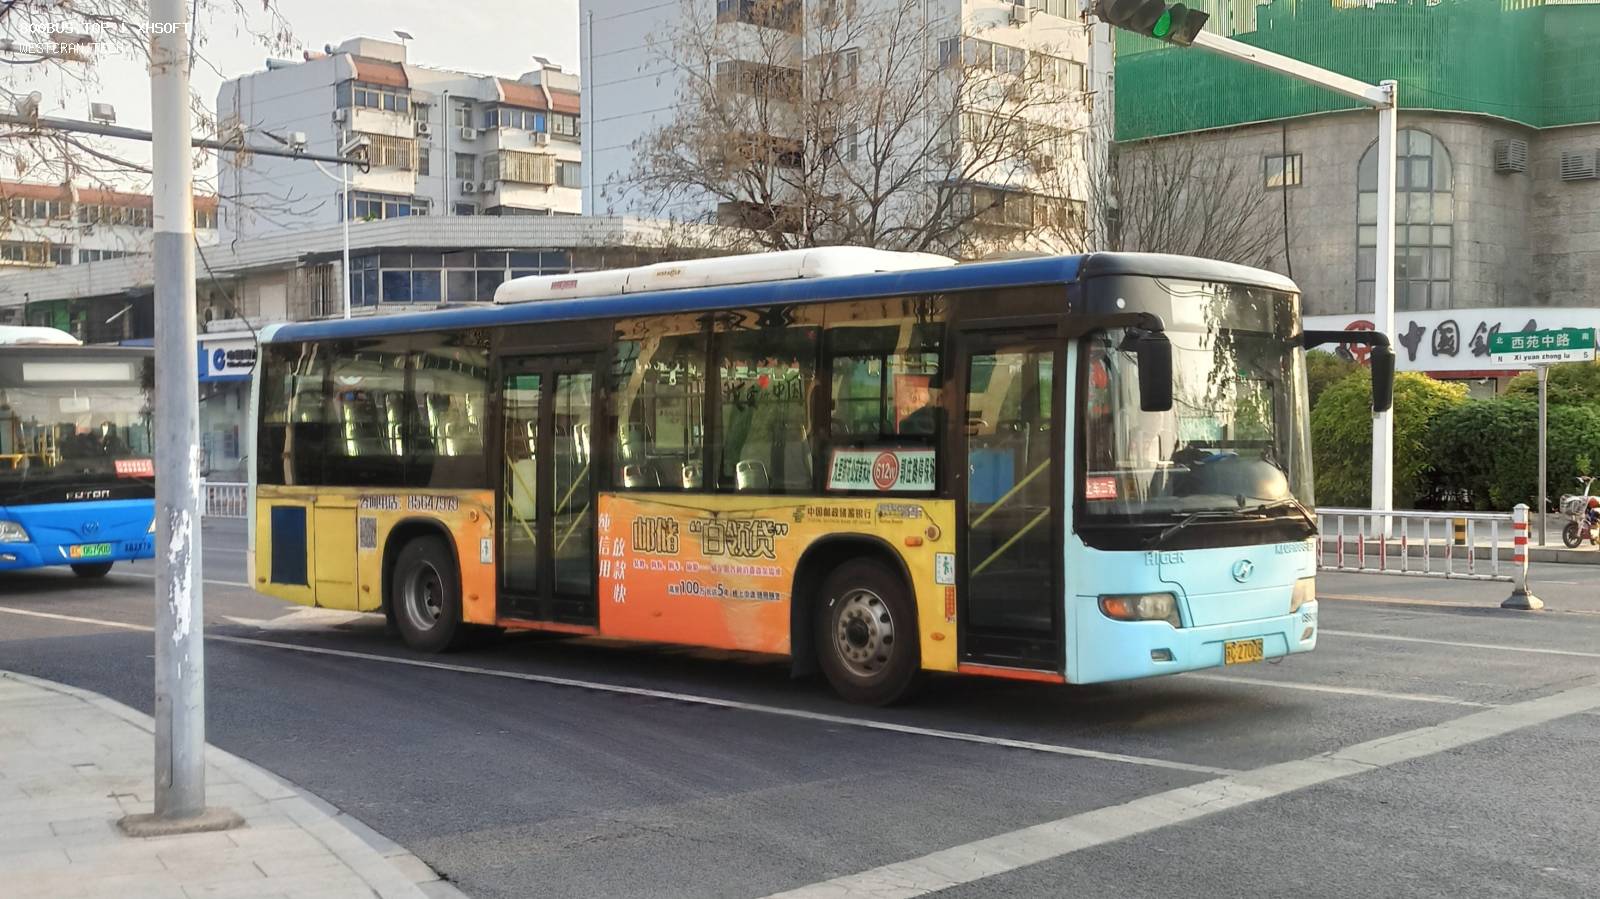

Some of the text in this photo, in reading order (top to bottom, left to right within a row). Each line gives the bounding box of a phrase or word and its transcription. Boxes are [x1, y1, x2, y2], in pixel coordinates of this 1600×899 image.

[1496, 336, 1504, 345] 北
[1511, 333, 1571, 349] 西苑中路
[1542, 353, 1562, 362] zhong
[1144, 551, 1185, 567] HIGER
